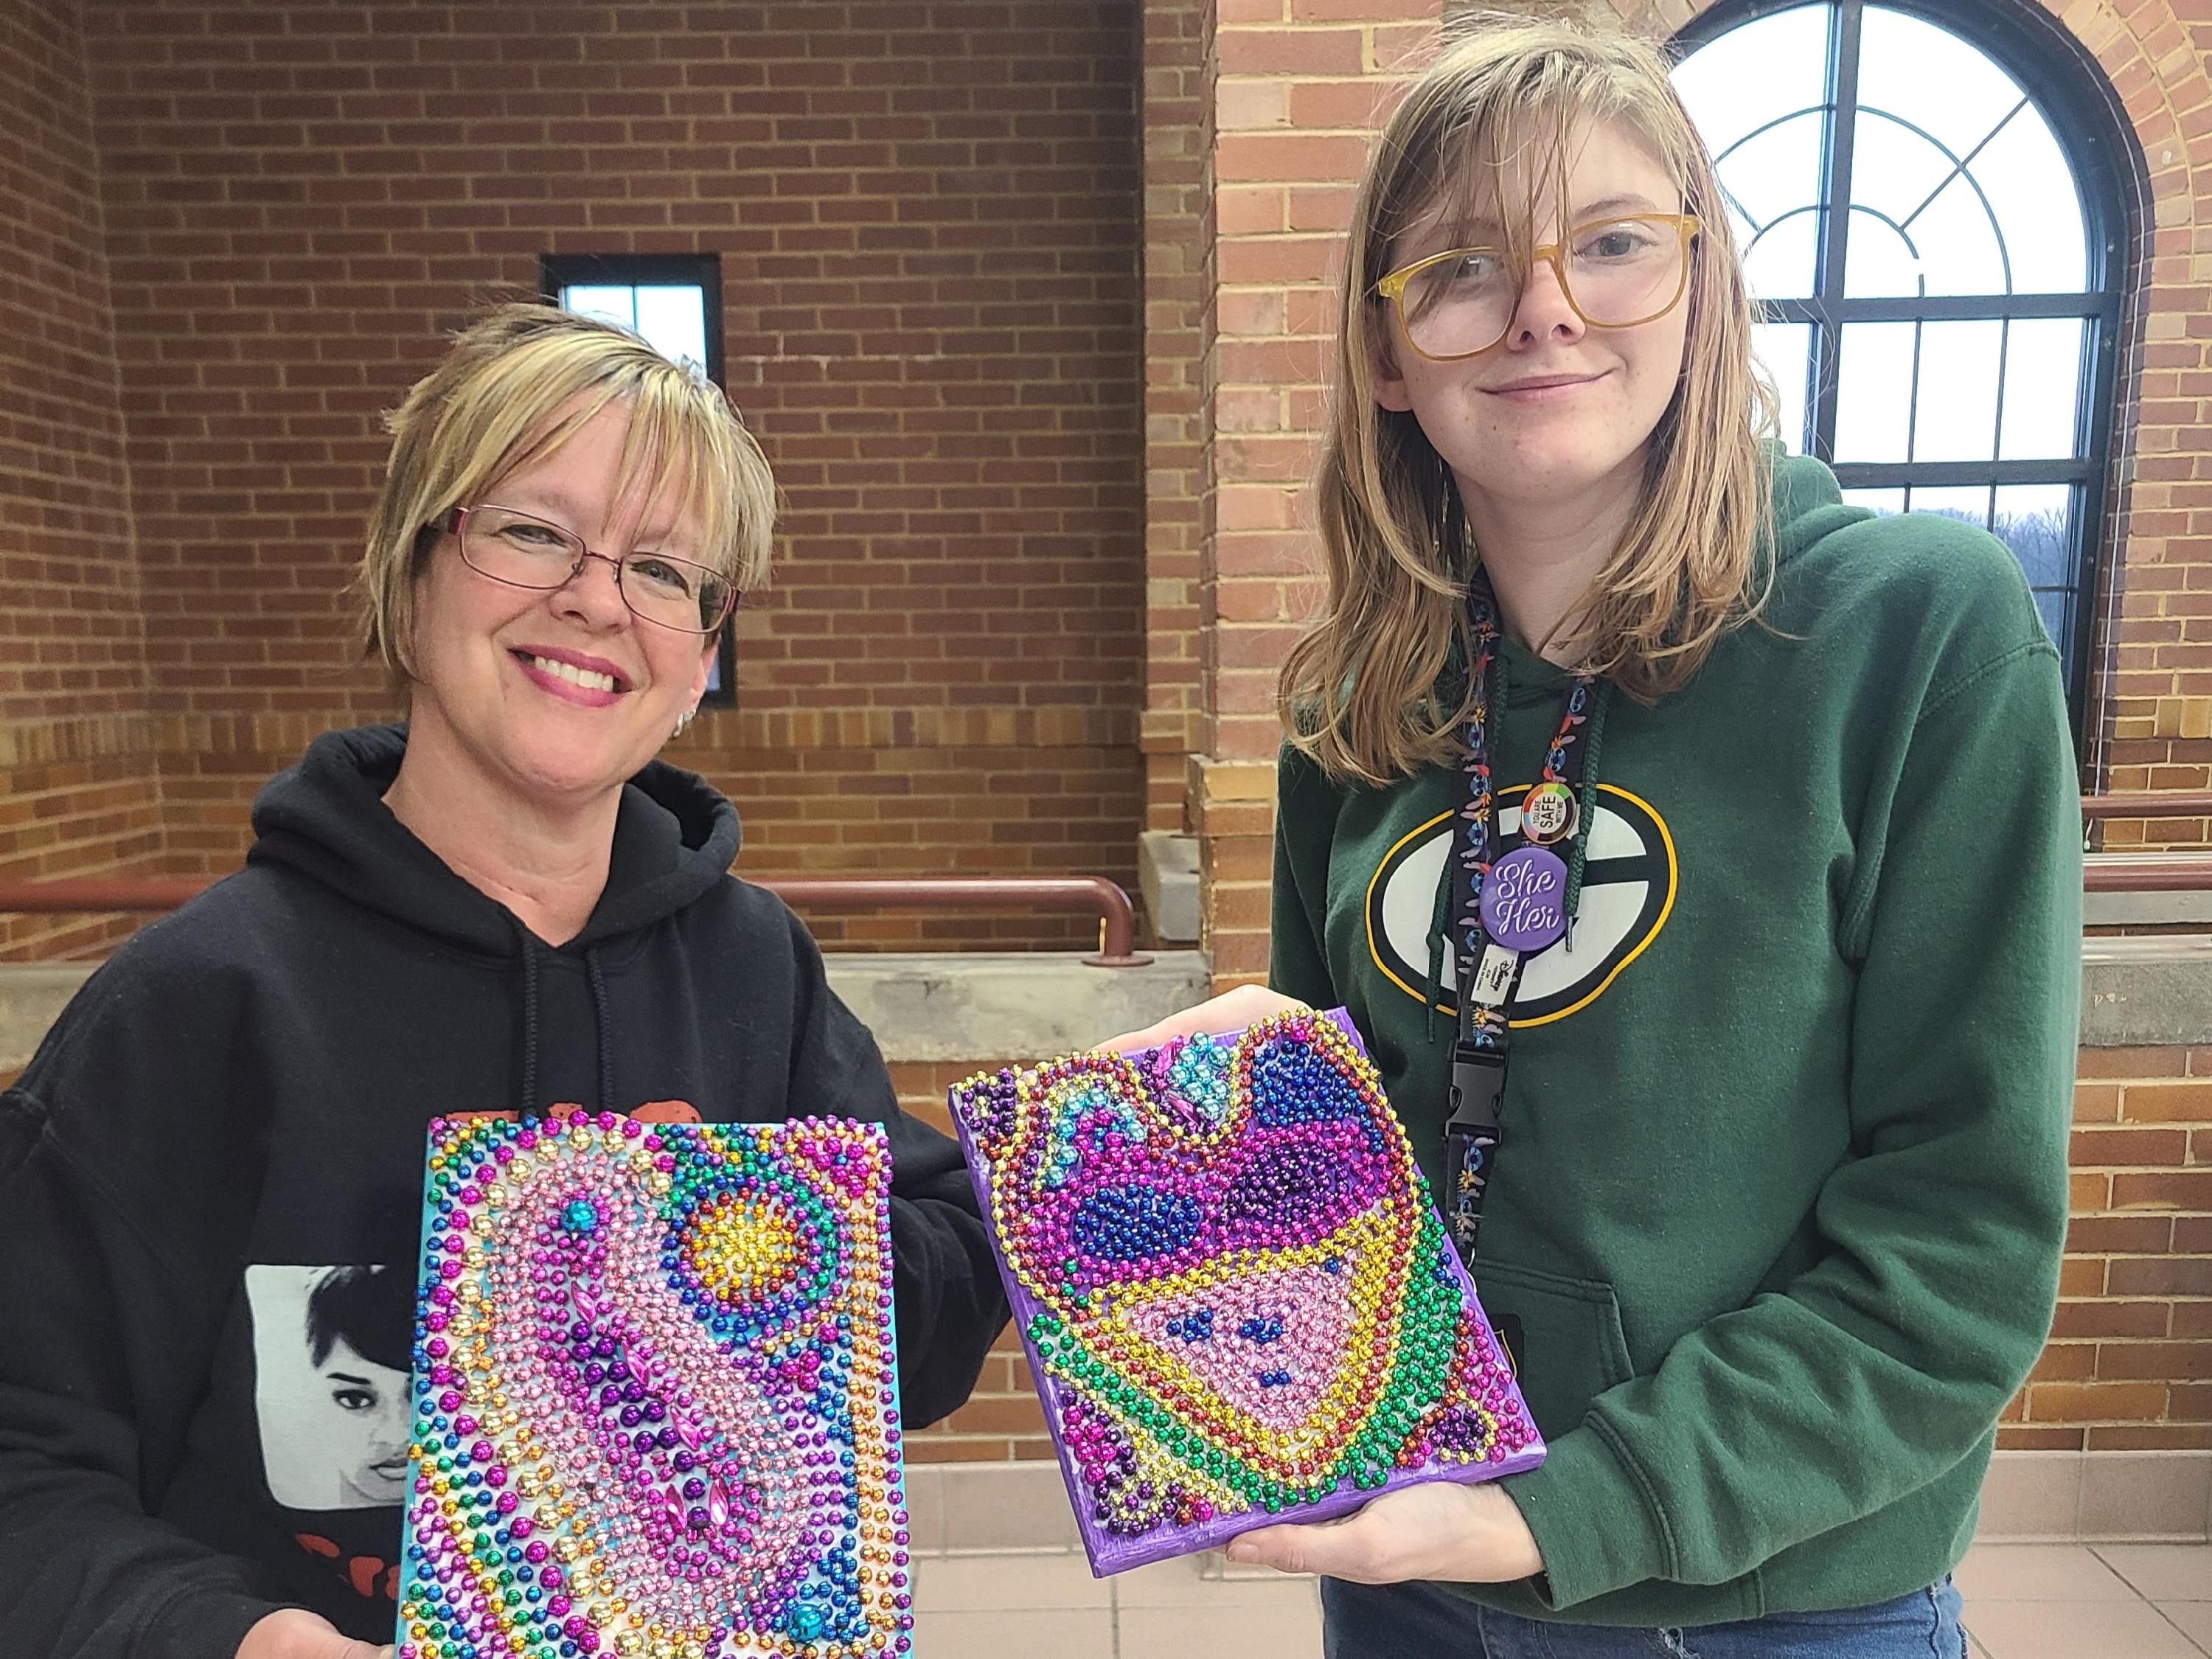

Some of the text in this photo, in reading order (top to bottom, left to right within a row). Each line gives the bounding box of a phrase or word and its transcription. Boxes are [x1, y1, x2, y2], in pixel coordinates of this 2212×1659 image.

[1534, 800, 1542, 812] ARE
[1540, 796, 1556, 828] SAFE
[1557, 801, 1564, 809] ME
[1495, 859, 1557, 899] She
[1496, 897, 1559, 935] Her
[1489, 959, 1514, 992] Disney
